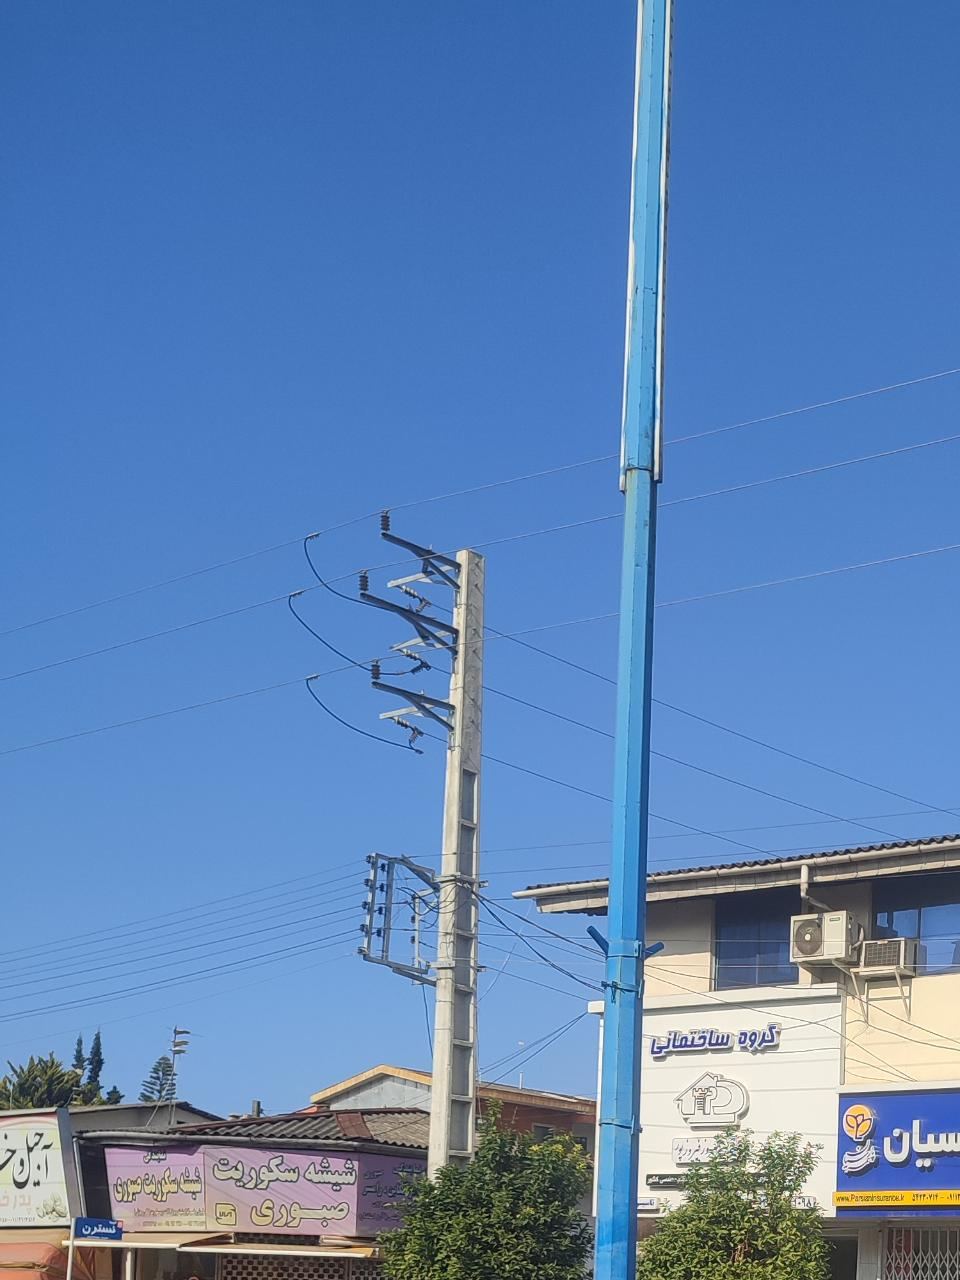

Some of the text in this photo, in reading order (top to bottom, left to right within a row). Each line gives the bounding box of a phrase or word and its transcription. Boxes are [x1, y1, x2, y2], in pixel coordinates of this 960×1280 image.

[650, 1024, 777, 1055] گروه ساختمانی
[212, 1155, 358, 1192] شیشه سکوریت
[250, 1198, 351, 1228] صبوری
